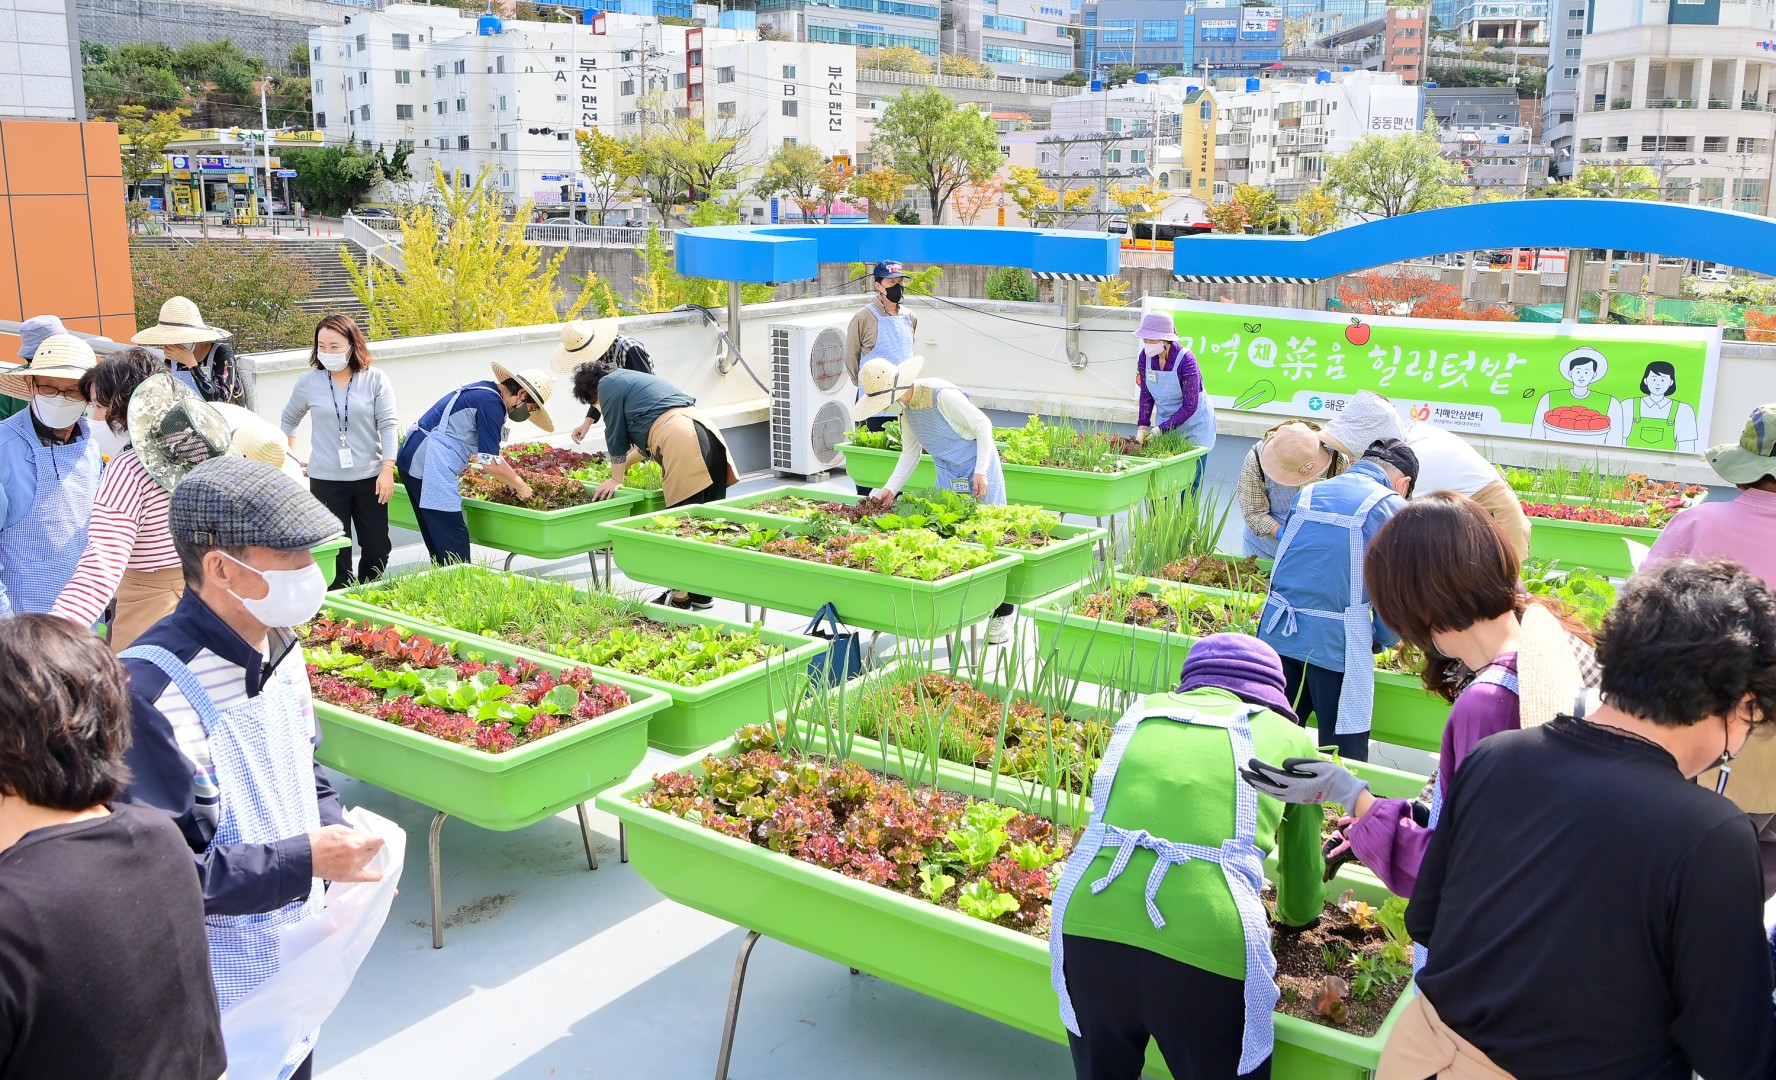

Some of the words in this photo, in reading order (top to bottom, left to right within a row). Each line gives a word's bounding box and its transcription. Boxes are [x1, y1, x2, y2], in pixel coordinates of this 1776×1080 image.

[555, 69, 567, 83] A
[783, 84, 796, 96] B
[1371, 116, 1414, 131] 중동맨션
[293, 131, 313, 141] Self
[1434, 408, 1484, 421] 치매안심센터
